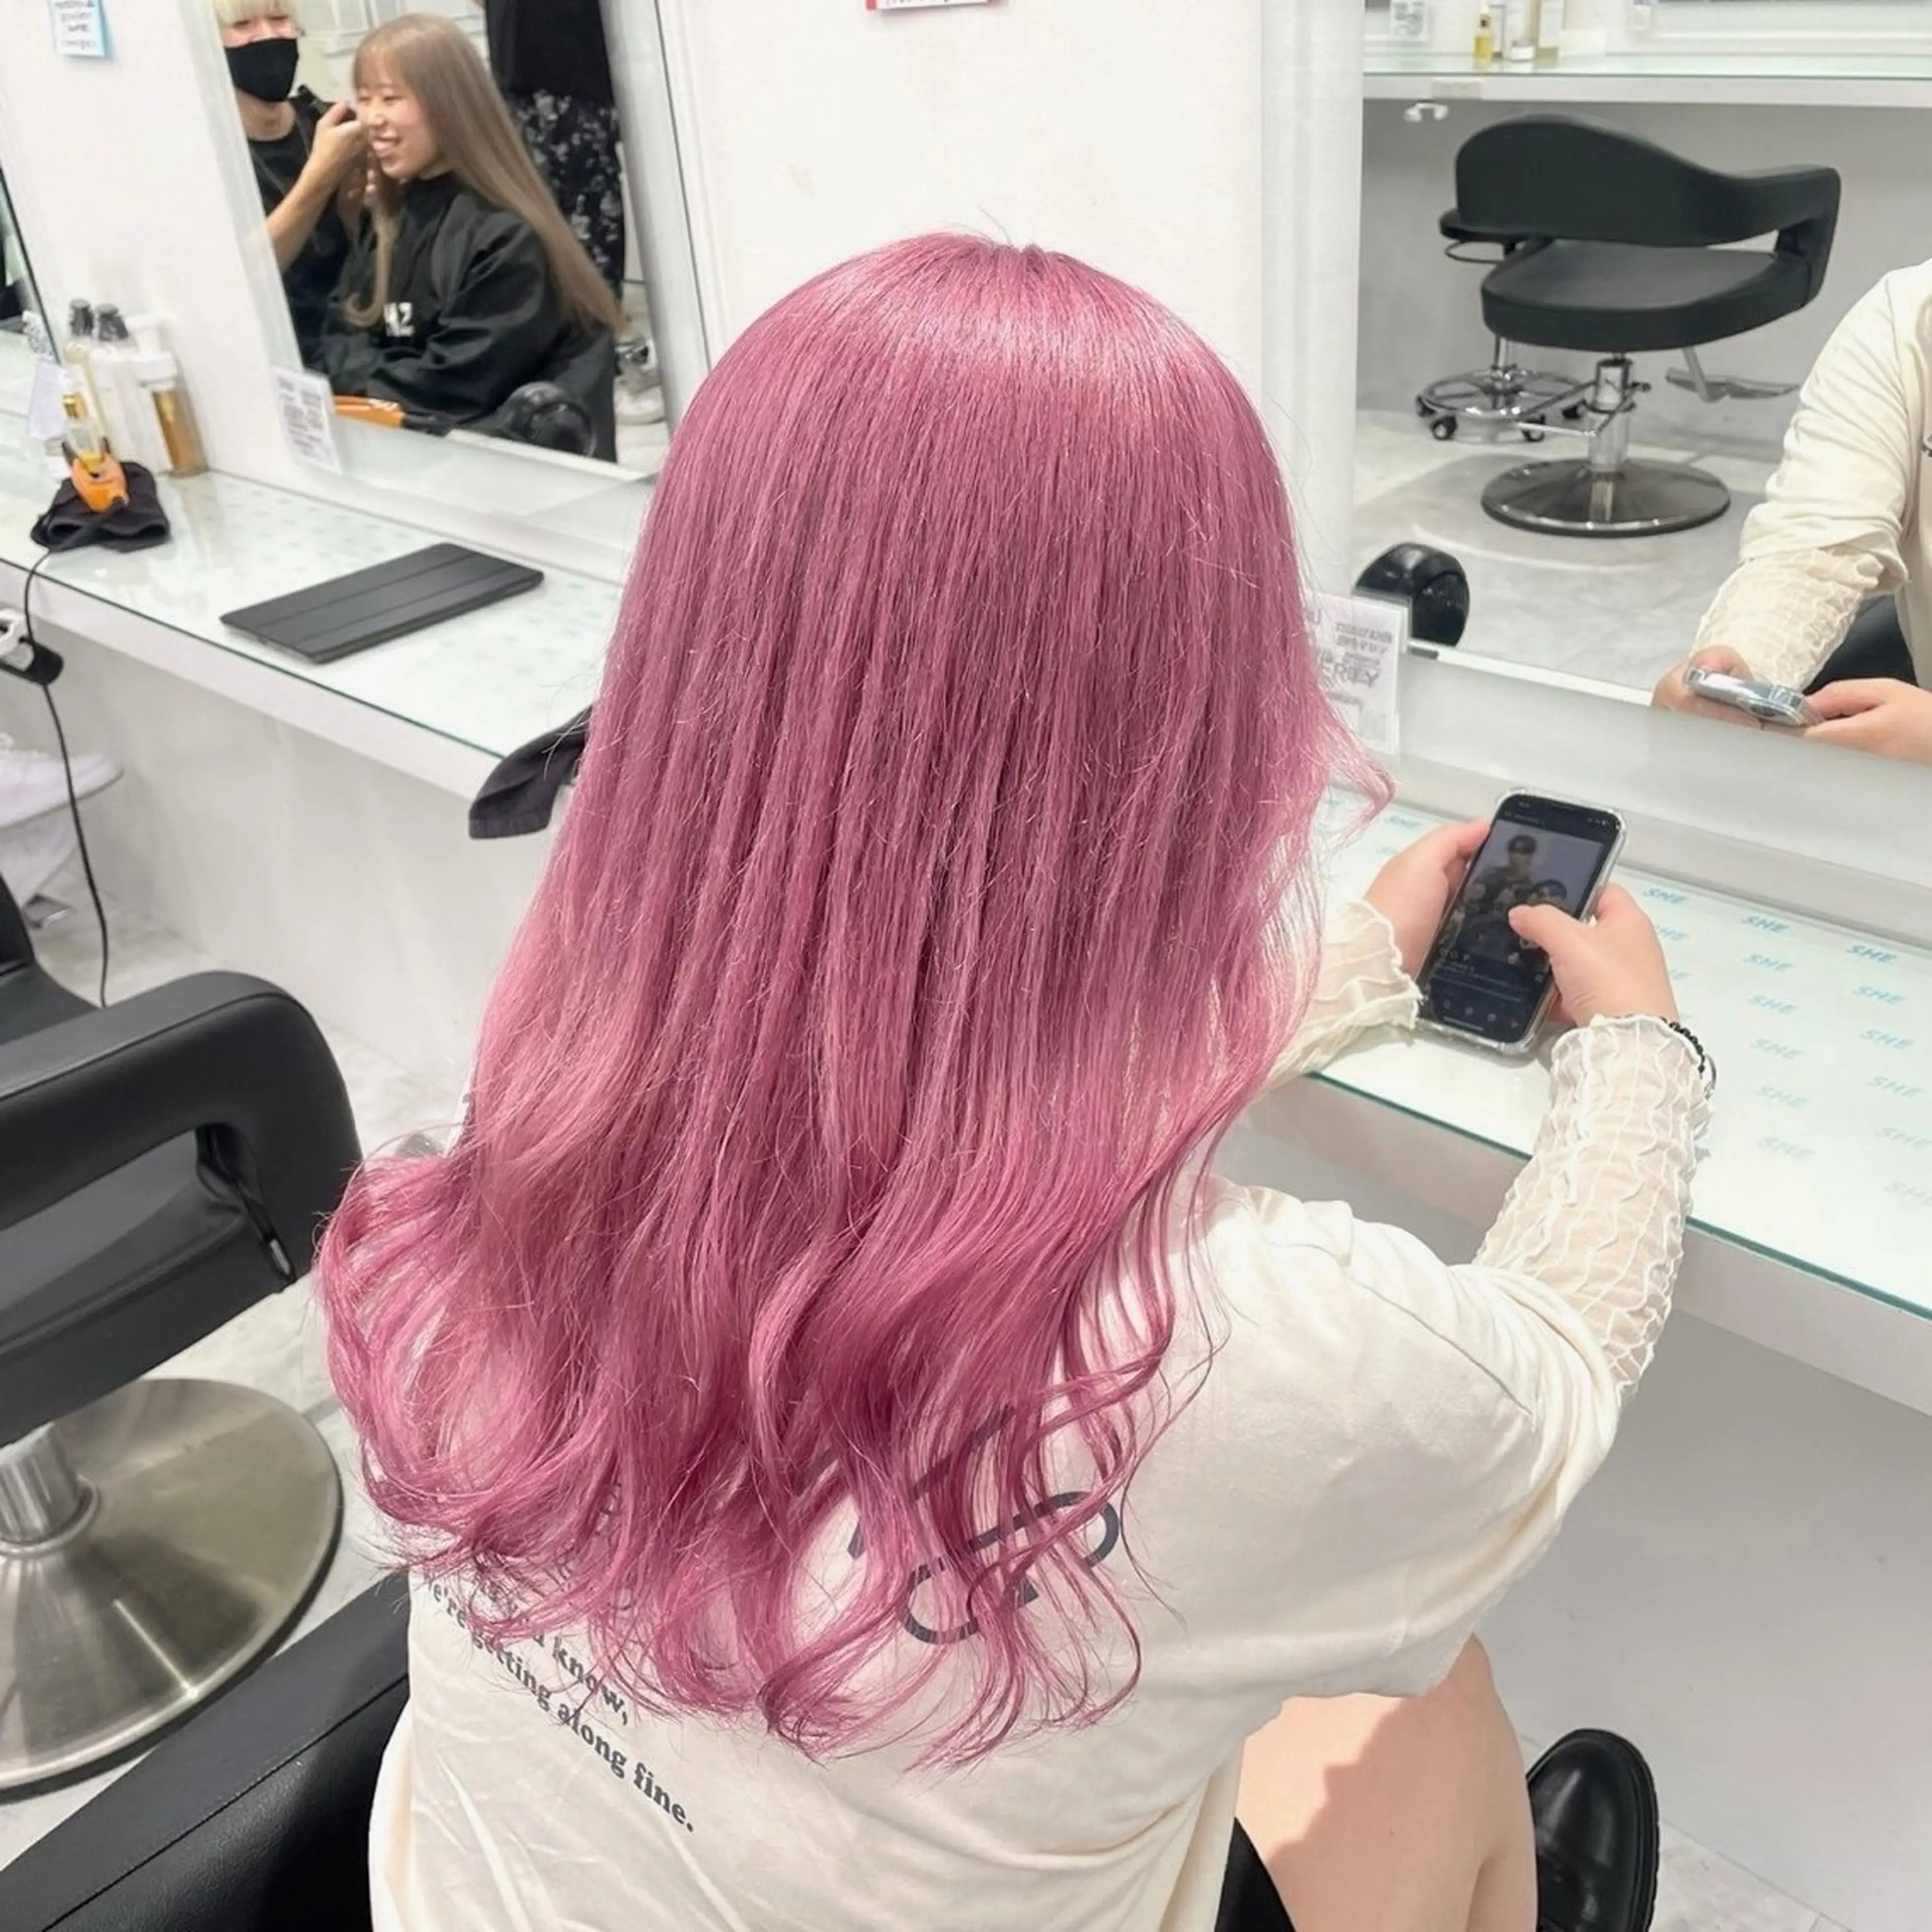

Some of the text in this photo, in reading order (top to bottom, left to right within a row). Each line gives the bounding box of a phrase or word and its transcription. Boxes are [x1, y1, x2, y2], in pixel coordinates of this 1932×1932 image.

[1741, 915, 1790, 934] SHE
[1743, 954, 1795, 973] SHE
[1846, 944, 1898, 964] SHE
[1747, 994, 1799, 1015] SHE
[1853, 985, 1905, 1006] SHE
[1860, 1029, 1914, 1051] SHE
[1867, 1076, 1925, 1099] SHE
[557, 1703, 627, 1779] along
[633, 1762, 693, 1832] fine.
